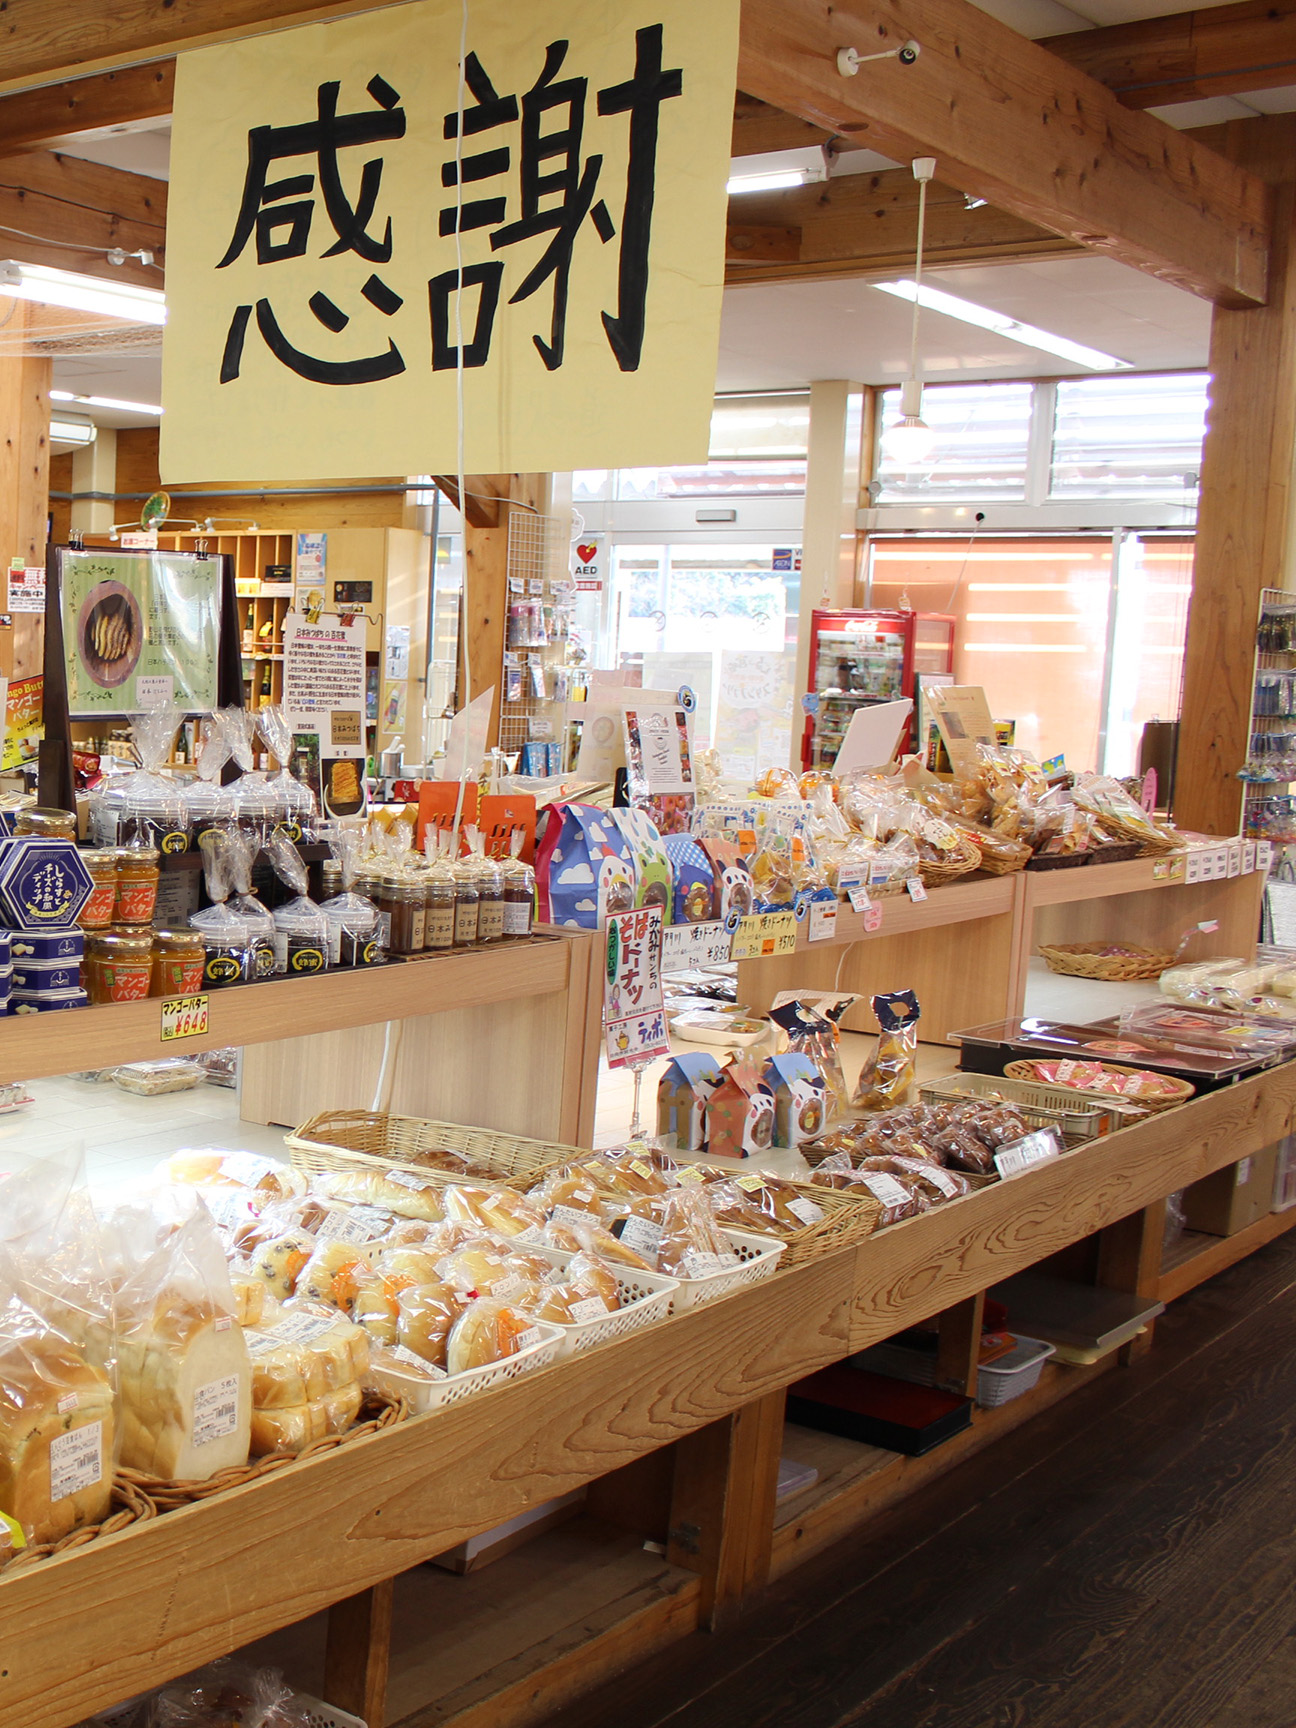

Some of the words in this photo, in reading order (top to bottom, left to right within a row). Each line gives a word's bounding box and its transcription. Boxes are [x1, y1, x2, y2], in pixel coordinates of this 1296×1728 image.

[215, 23, 683, 386] 感謝
[575, 566, 598, 575] AED
[6, 694, 41, 711] マンゴー
[13, 709, 41, 722] バター
[32, 870, 46, 905] ディップ
[42, 863, 56, 910] チーズの和風
[54, 864, 65, 906] しらすと
[619, 912, 649, 943] そば
[648, 916, 661, 990] みかみサンちの
[707, 944, 730, 961] ¥850
[620, 943, 644, 1005] ドーナツ
[163, 998, 208, 1015] マンゴーバター
[175, 1011, 207, 1035] ¥648
